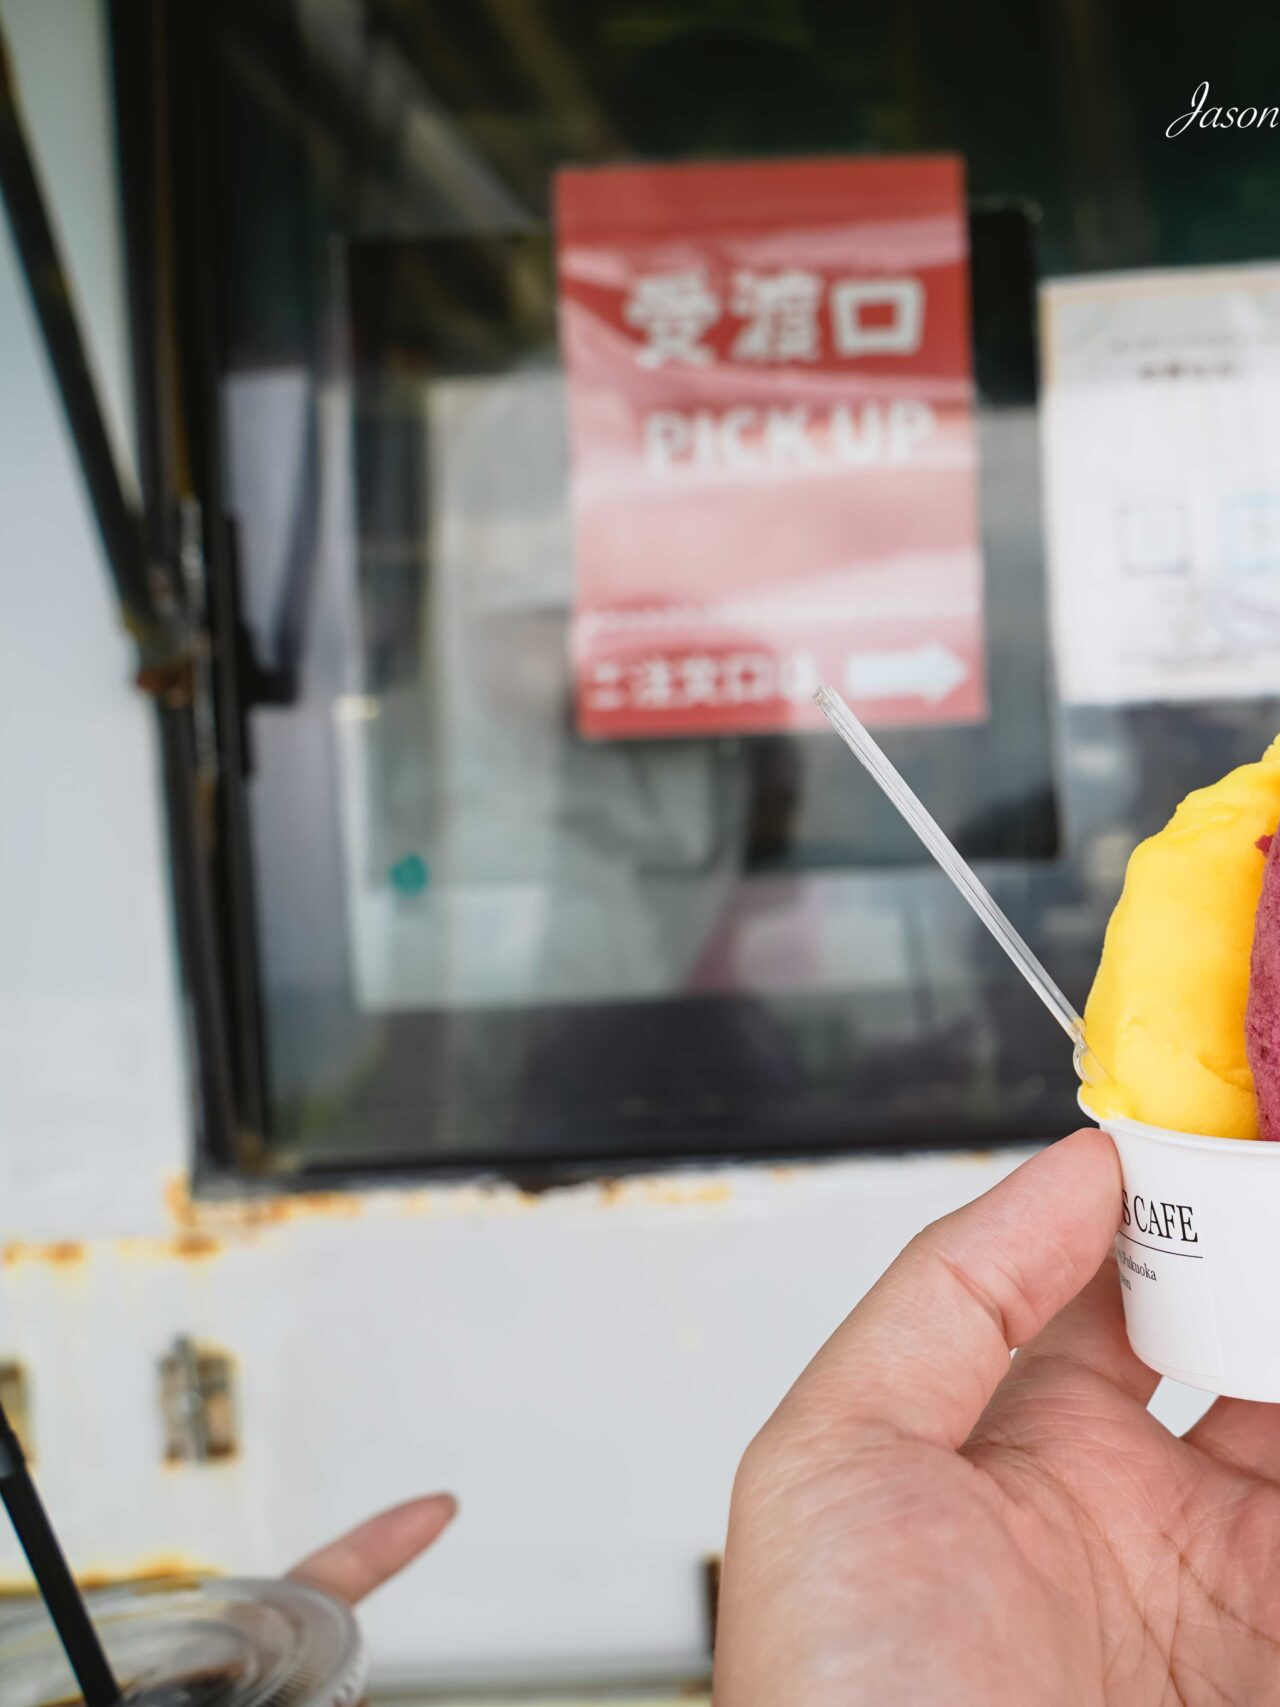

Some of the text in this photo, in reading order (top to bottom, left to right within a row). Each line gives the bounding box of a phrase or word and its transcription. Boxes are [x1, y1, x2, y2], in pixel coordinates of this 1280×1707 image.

[623, 267, 926, 369] 受渡口
[644, 400, 936, 478] PICK UP
[1133, 1195, 1198, 1243] CAFE
